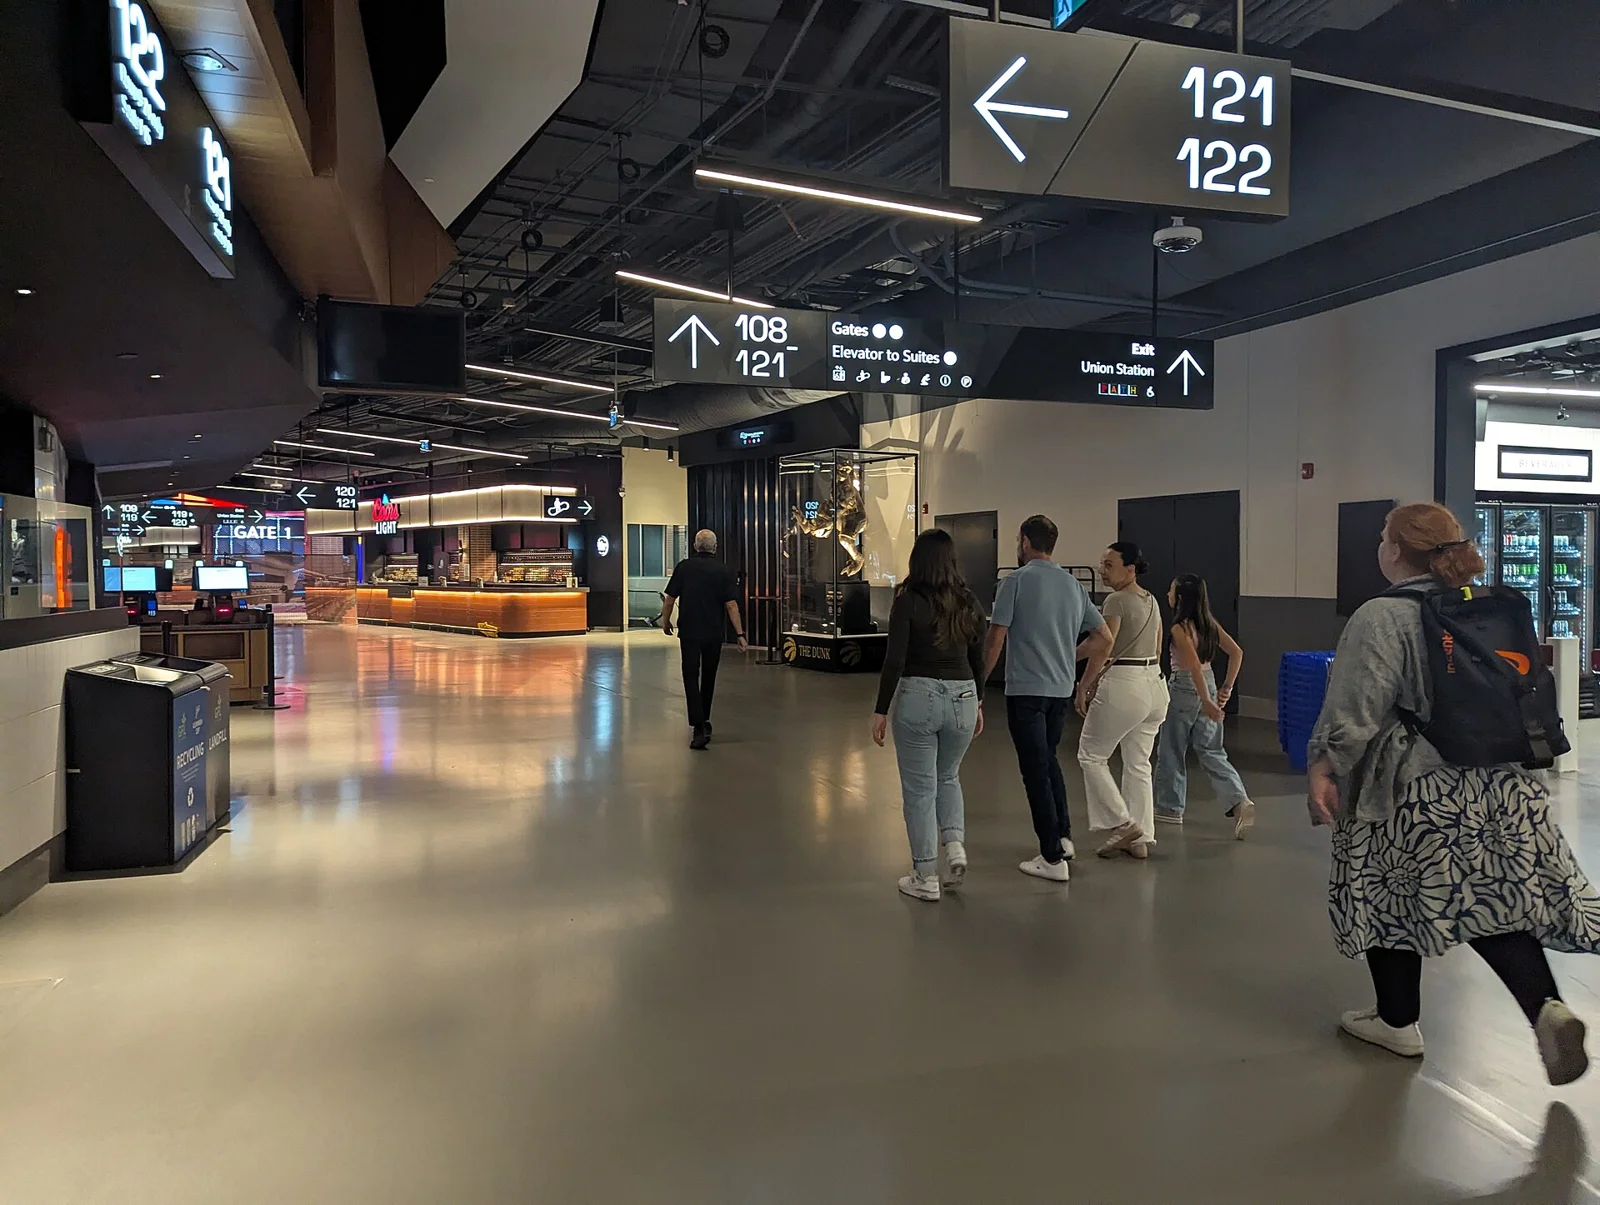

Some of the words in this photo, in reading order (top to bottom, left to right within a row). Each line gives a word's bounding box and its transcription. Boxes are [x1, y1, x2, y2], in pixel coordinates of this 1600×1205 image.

[1181, 66, 1274, 127] 121
[1176, 137, 1272, 196] 122
[831, 321, 869, 337] Gates
[832, 344, 884, 361] Elevator
[886, 348, 900, 361] to
[902, 349, 940, 364] Suites
[1131, 342, 1155, 356] Exit
[735, 349, 785, 378] 121
[1081, 360, 1114, 375] Union
[1116, 362, 1155, 377] Station
[1098, 382, 1138, 397] PATH
[335, 486, 356, 497] 120
[336, 498, 356, 508] 121
[372, 498, 400, 522] Coors
[234, 525, 278, 540] GATE
[284, 527, 292, 540] 1
[375, 521, 397, 535] LIGHT
[799, 644, 811, 658] THE
[811, 646, 831, 660] DUNK
[176, 741, 205, 770] RECYCLING
